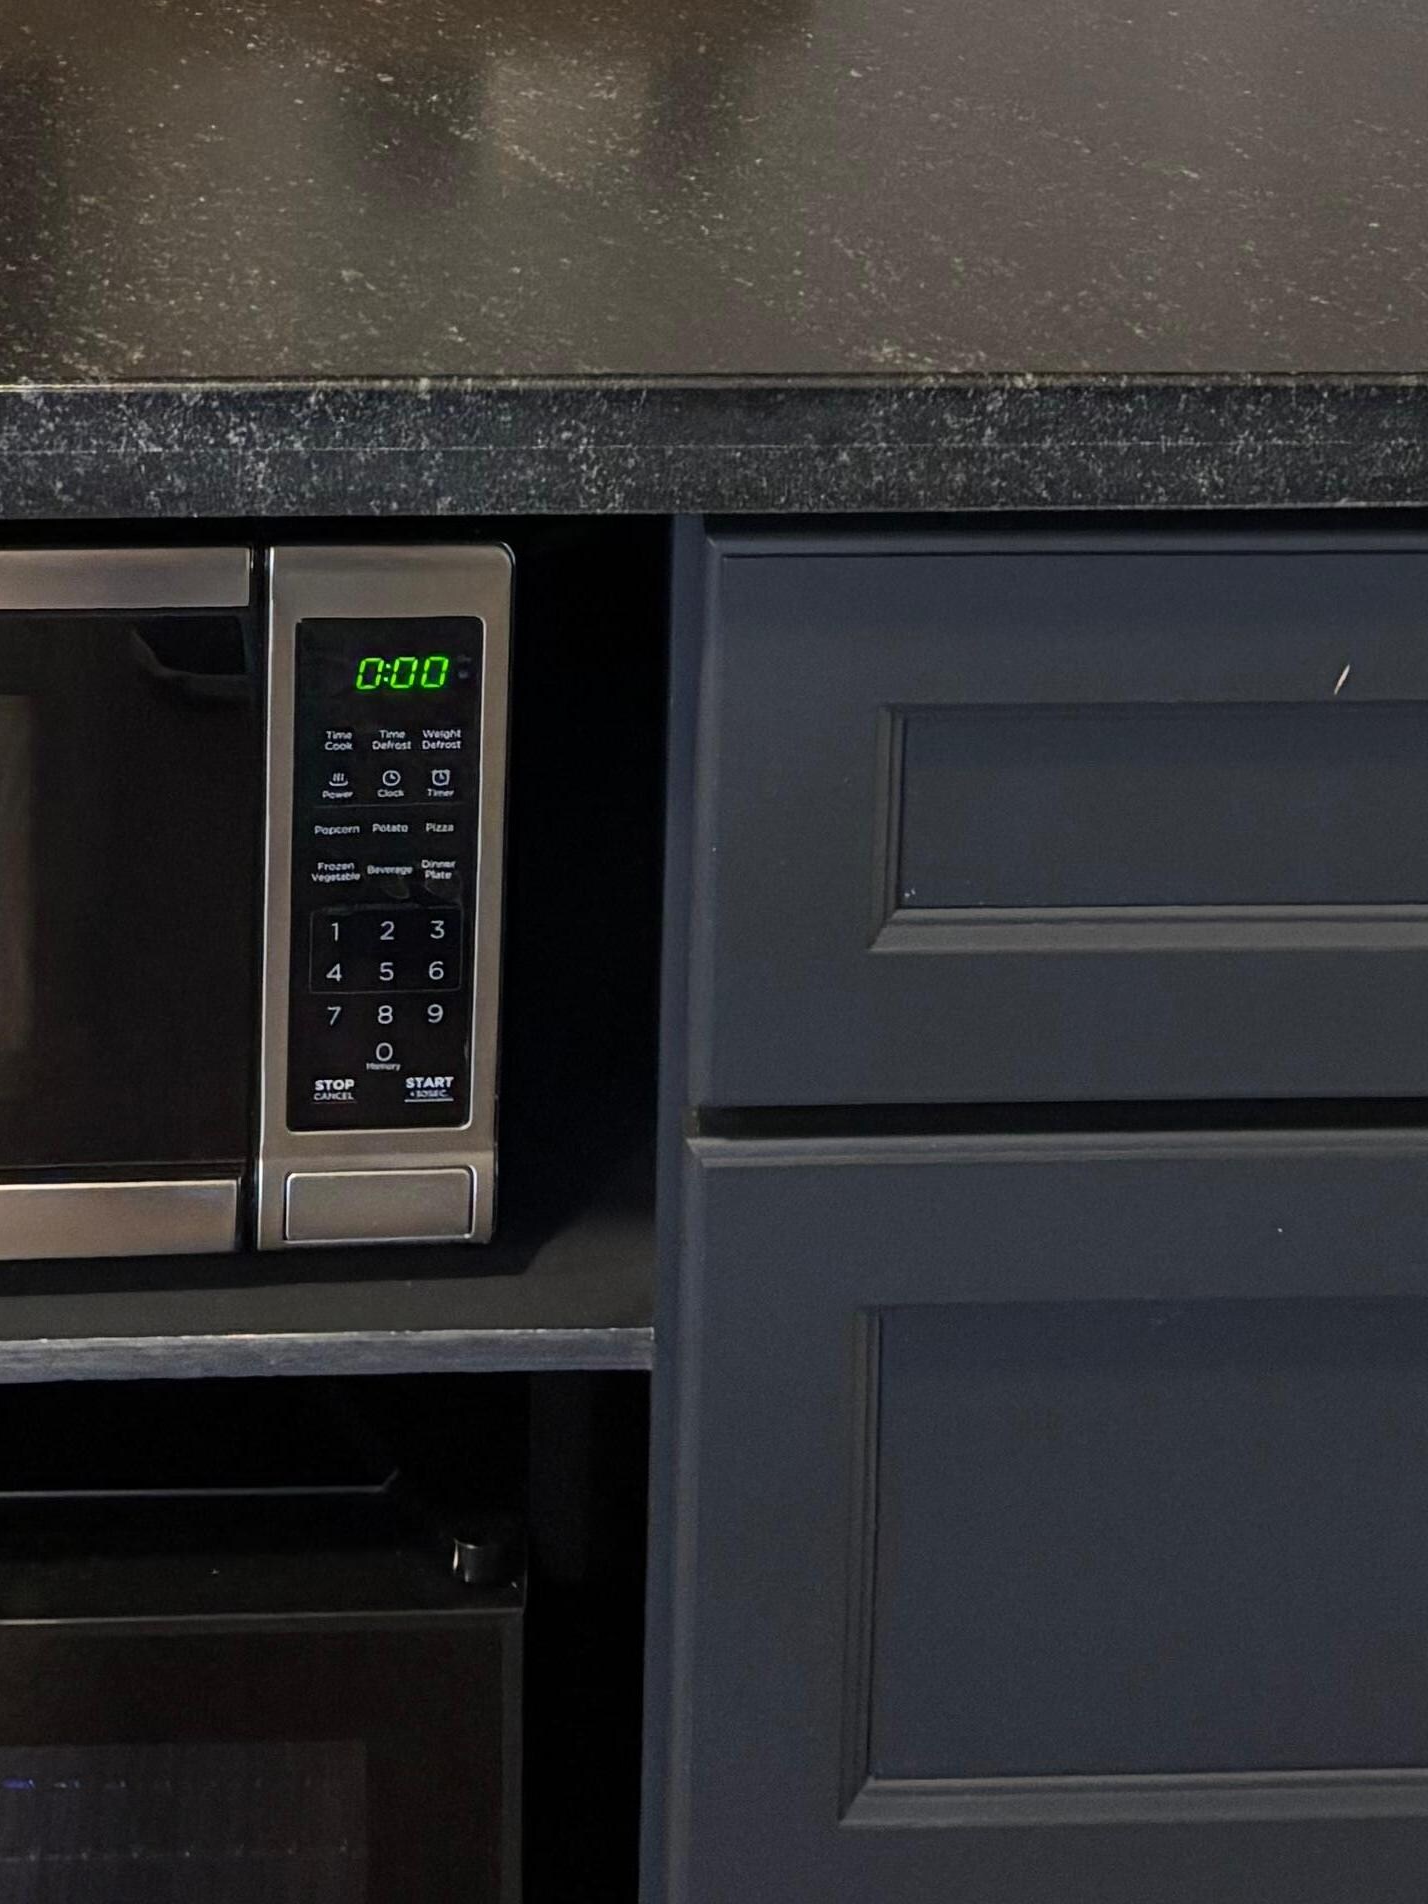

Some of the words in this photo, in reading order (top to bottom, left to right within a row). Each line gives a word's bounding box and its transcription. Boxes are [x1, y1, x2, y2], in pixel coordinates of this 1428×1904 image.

[355, 656, 450, 691] 0:00
[325, 730, 352, 740] Time
[380, 729, 406, 739] Time
[422, 729, 461, 739] Weight
[324, 742, 352, 751] Cook
[372, 741, 411, 750] Defrost
[422, 740, 461, 749] Defrost
[322, 790, 353, 799] Power
[377, 789, 404, 797] Clock
[427, 789, 454, 797] Timer
[314, 824, 360, 836] Popcorn
[372, 823, 408, 833] Potato
[425, 823, 454, 832] Pizza
[317, 862, 354, 872] Frozen
[421, 859, 456, 869] Dinner
[367, 865, 412, 875] Beverage
[425, 870, 451, 879] Plate
[311, 872, 361, 882] Vegetable
[330, 923, 340, 940] 1
[380, 922, 395, 939] 2
[429, 922, 445, 939] 3
[326, 964, 343, 981] 4
[379, 963, 394, 980] 5
[428, 961, 444, 979] 6
[327, 1006, 342, 1025] 7
[377, 1005, 393, 1023] 8
[427, 1004, 443, 1023] 9
[376, 1042, 394, 1062] 0
[314, 1079, 354, 1091] STOP
[406, 1076, 453, 1090] START
[314, 1092, 353, 1100] CANCEL
